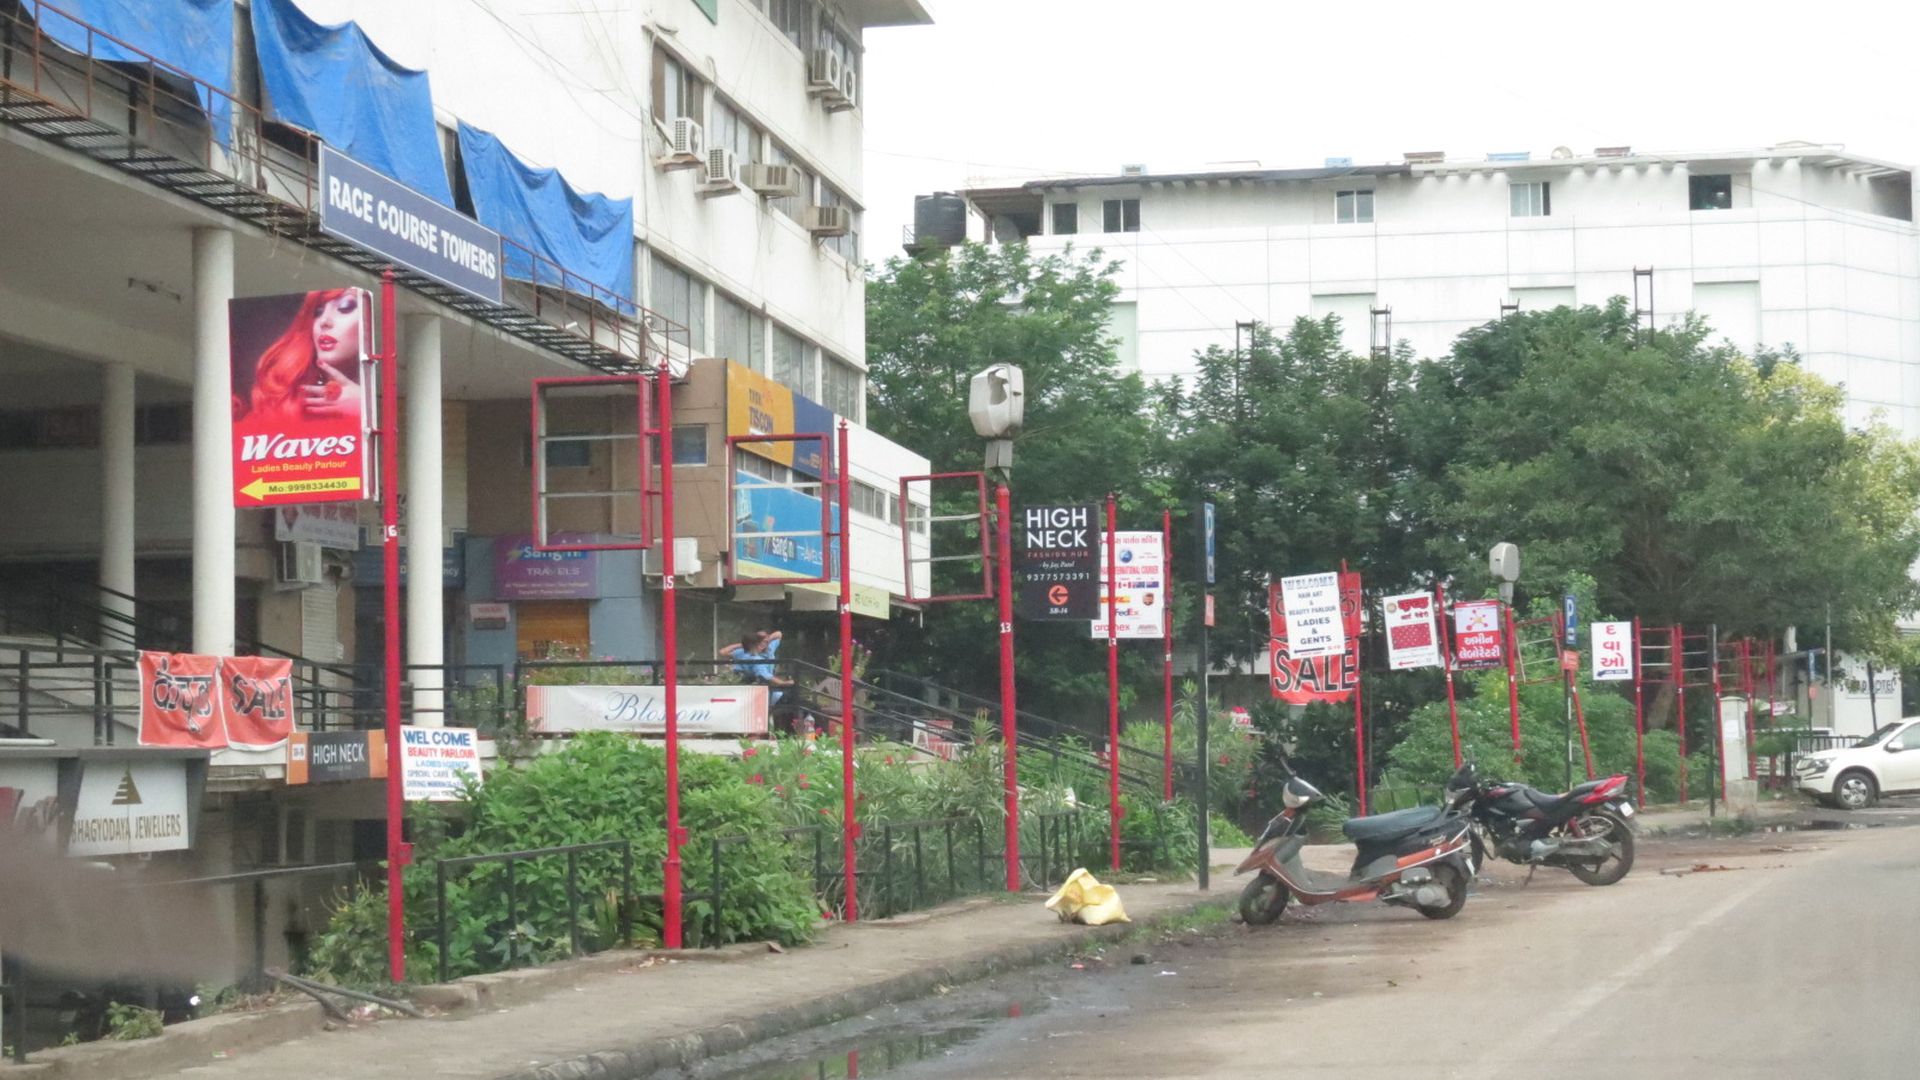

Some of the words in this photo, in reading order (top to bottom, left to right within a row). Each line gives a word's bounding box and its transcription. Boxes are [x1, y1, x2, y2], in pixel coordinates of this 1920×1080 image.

[329, 175, 374, 224] RACE
[377, 199, 439, 254] COURSE
[440, 229, 497, 280] TOWERS
[241, 433, 356, 462] Waves
[251, 463, 281, 474] Ladies
[282, 462, 313, 473] Beauty
[315, 460, 347, 469] Parlour
[1026, 507, 1087, 529] HIGH
[1026, 529, 1088, 549] NECK
[1297, 616, 1331, 627] LADIES
[1300, 635, 1332, 645] GENTS
[1274, 646, 1358, 692] SALE
[604, 690, 711, 722] Blosom
[312, 743, 337, 765] HIGH
[339, 742, 366, 763] NECK
[407, 746, 438, 758] BEAUTY
[440, 747, 476, 759] PARLOUR
[72, 814, 131, 844] BHAGYODAYA
[135, 813, 182, 840] JEWELLERS
